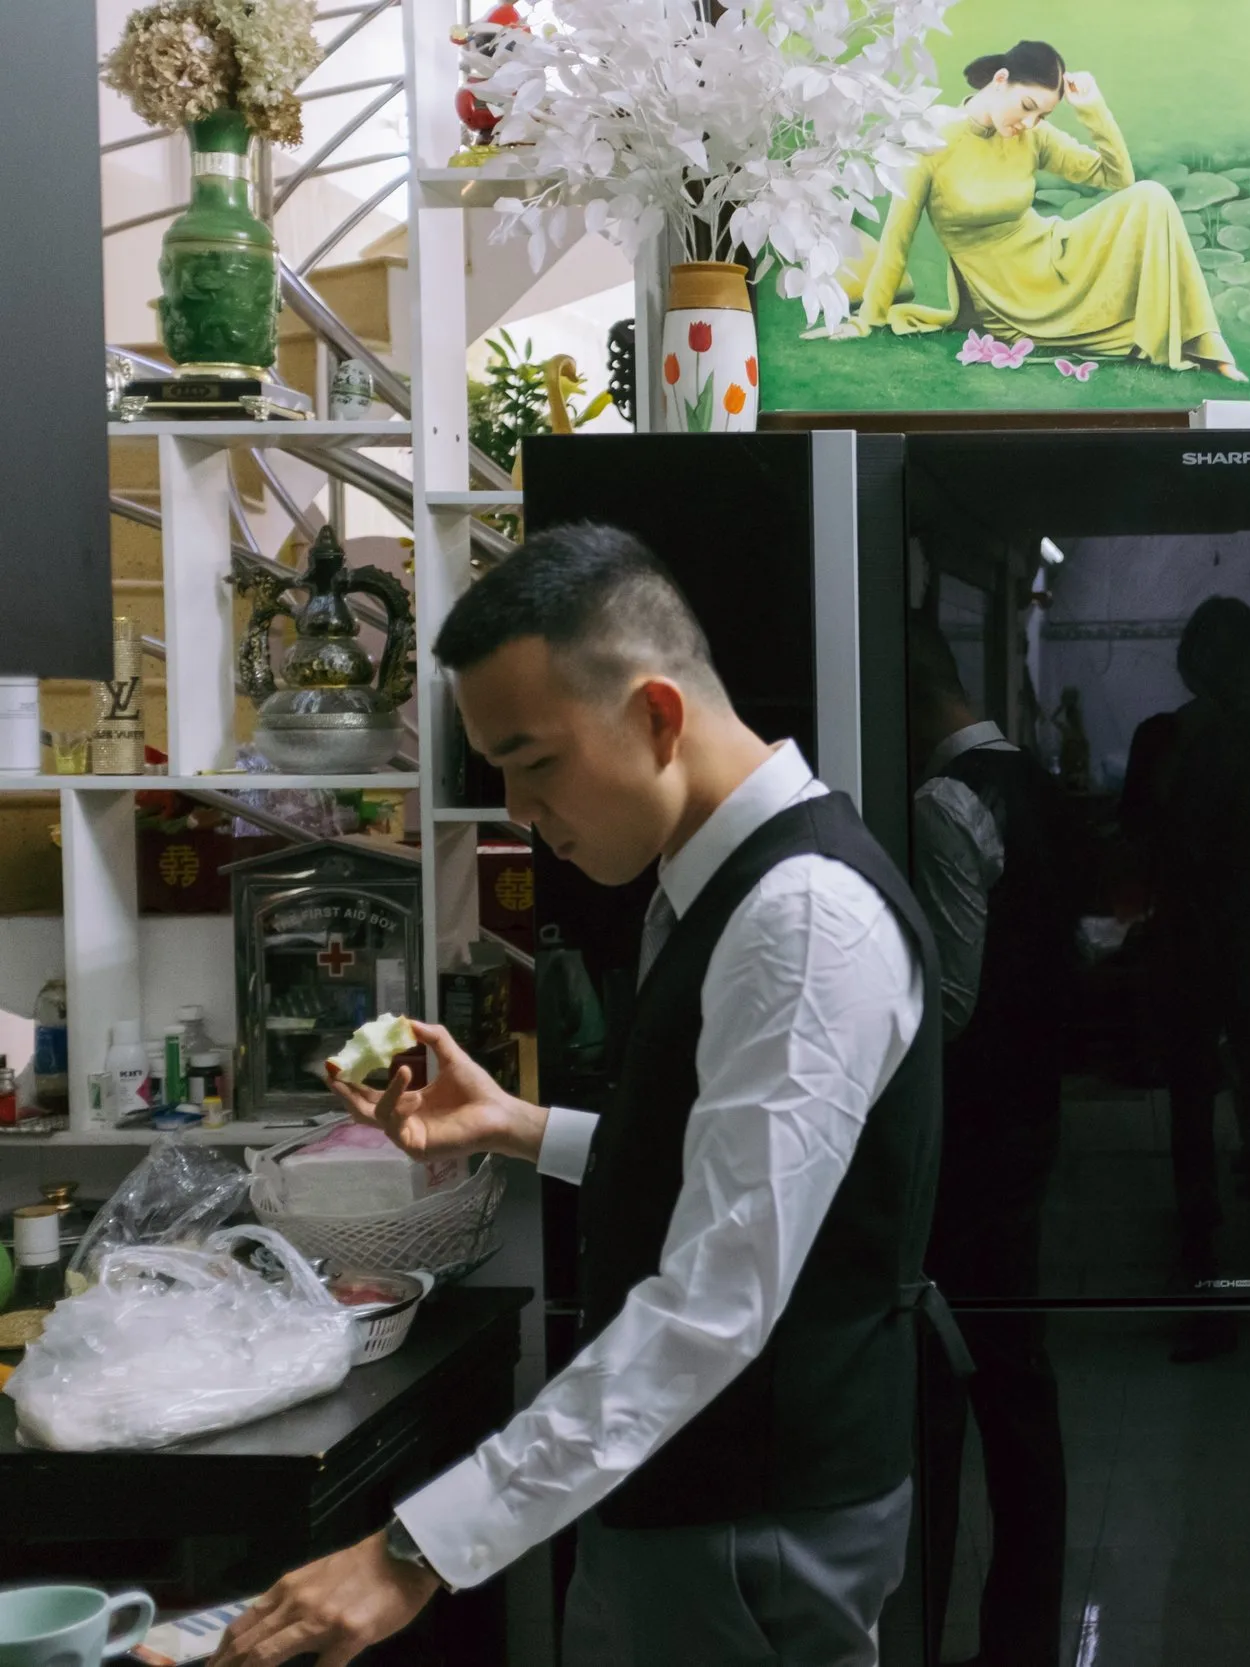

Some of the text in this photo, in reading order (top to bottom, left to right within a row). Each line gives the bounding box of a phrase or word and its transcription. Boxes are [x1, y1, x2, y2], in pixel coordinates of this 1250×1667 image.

[301, 906, 341, 920] FIRST
[344, 908, 367, 921] AID
[370, 913, 398, 933] BOX
